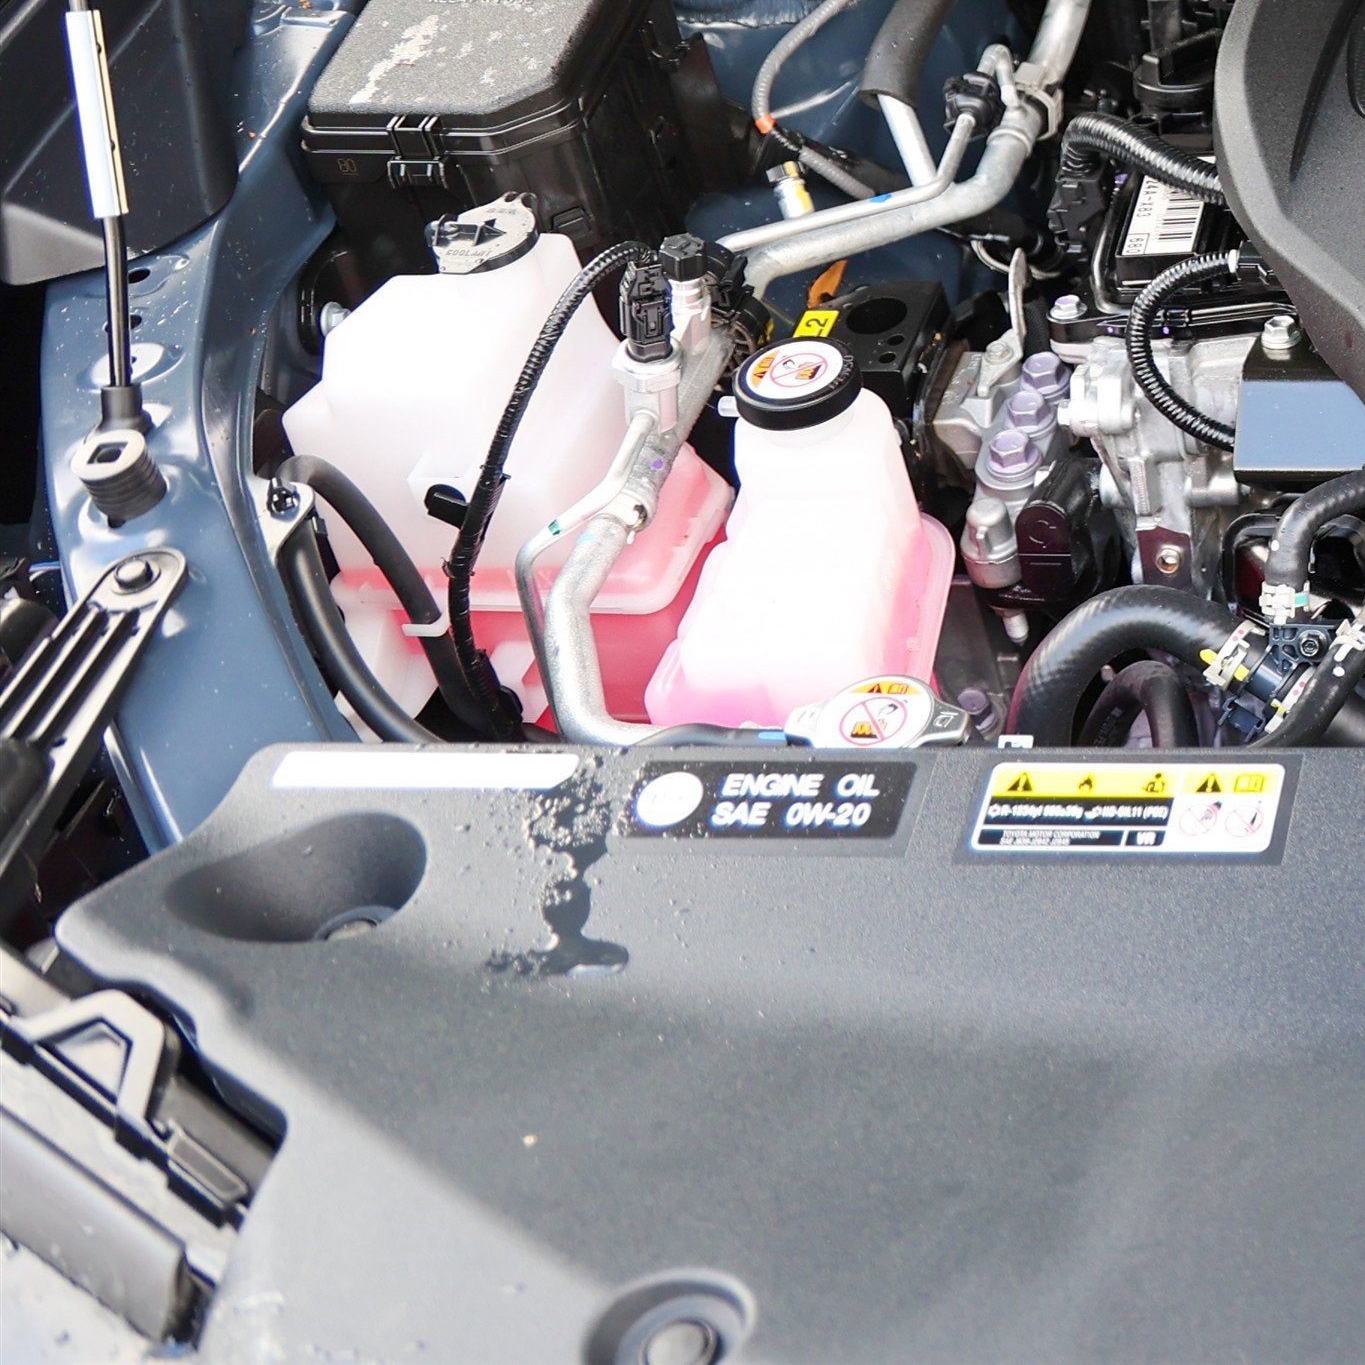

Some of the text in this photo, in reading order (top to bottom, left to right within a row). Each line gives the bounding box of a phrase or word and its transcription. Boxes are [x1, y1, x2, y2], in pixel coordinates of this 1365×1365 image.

[445, 247, 494, 258] COOLANT
[720, 773, 880, 797] ENGINE OIL
[711, 801, 872, 826] SAE 0W-20
